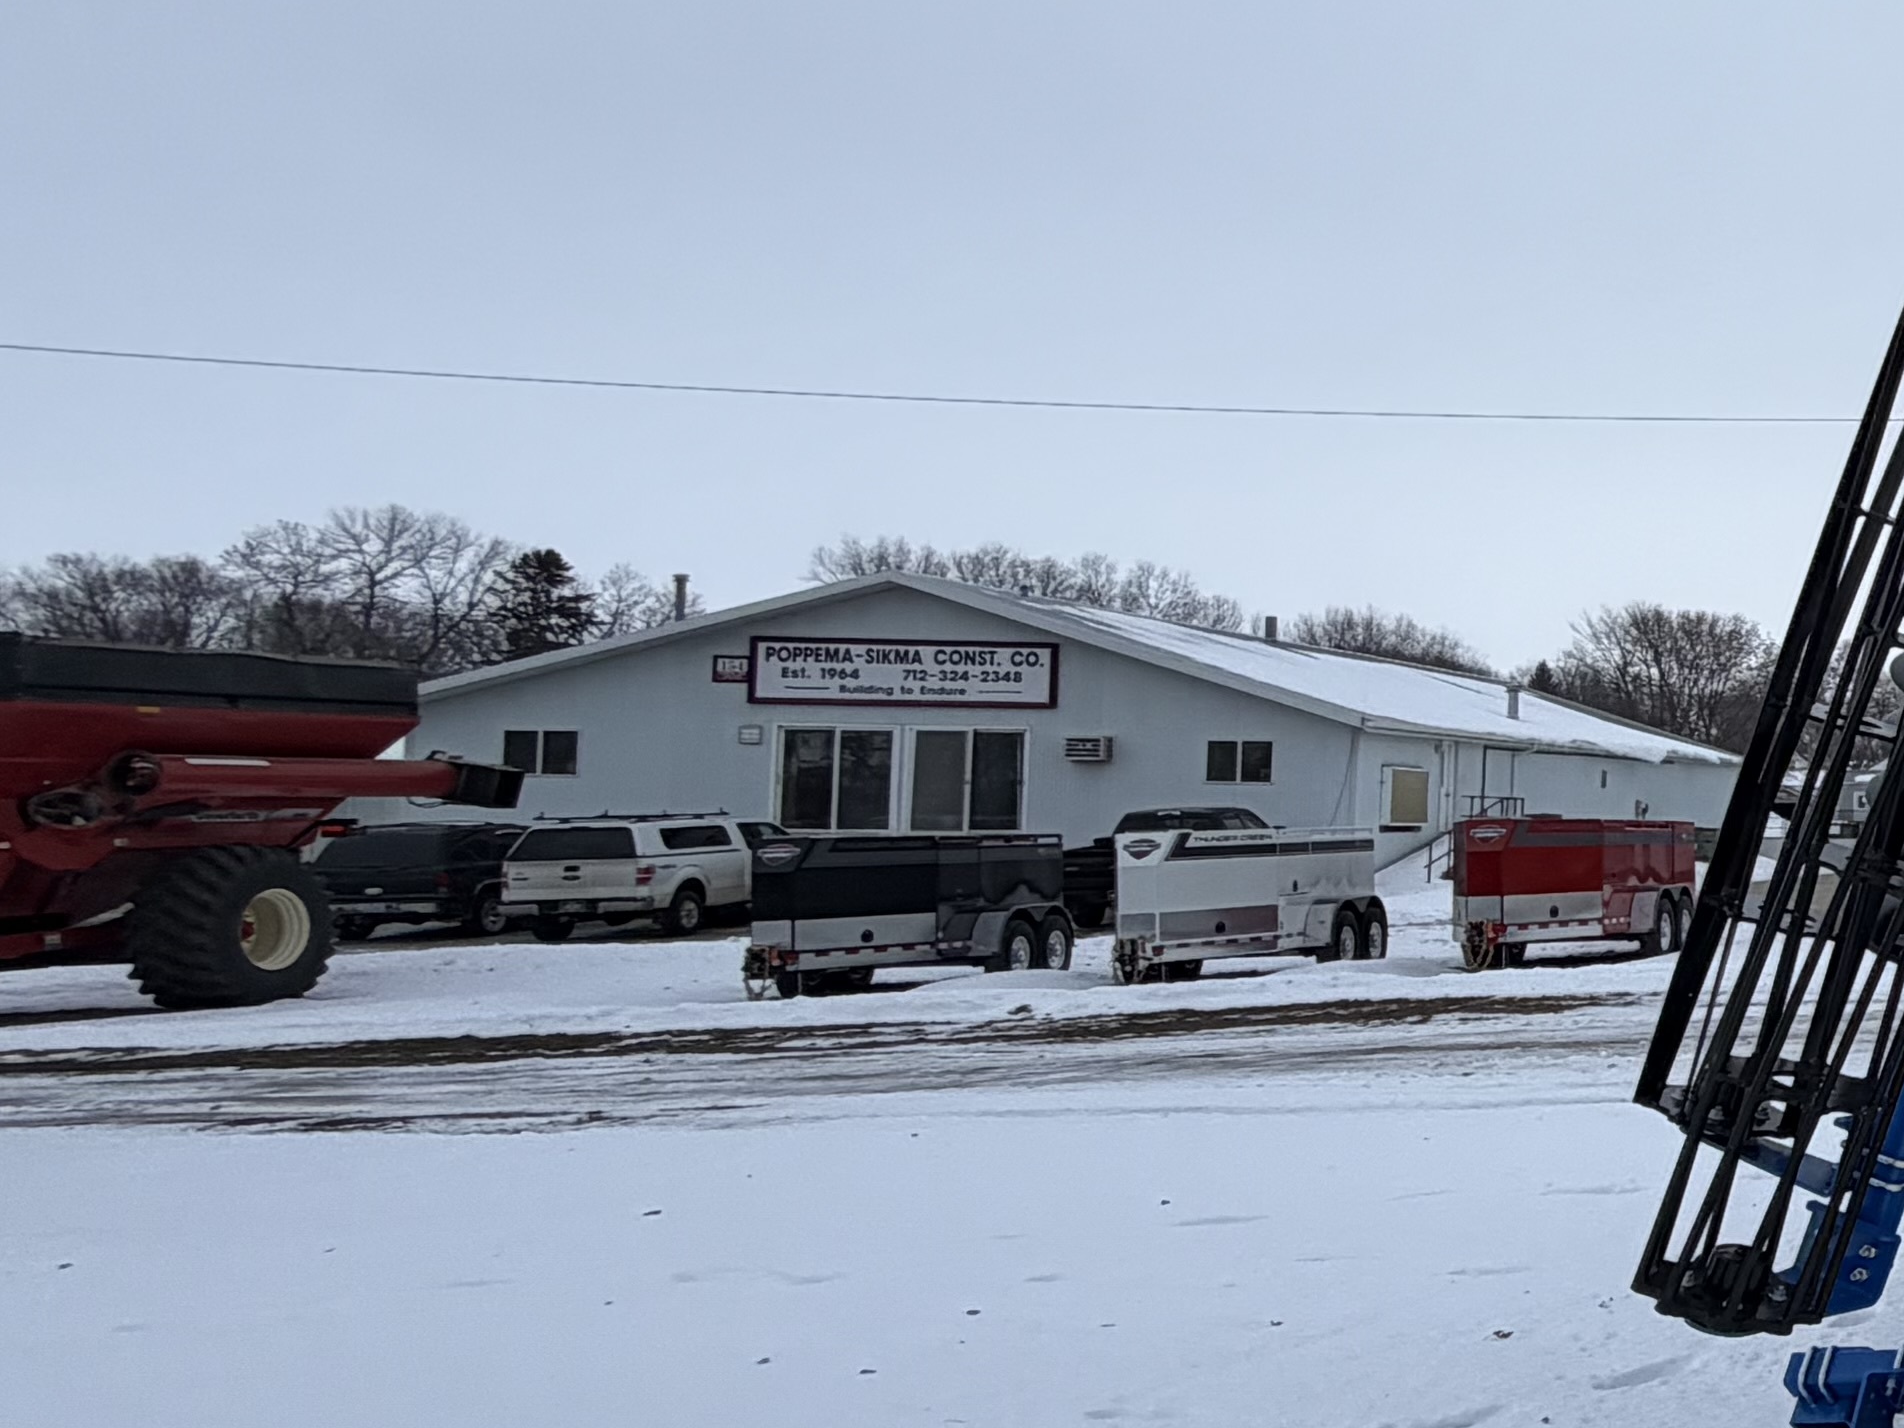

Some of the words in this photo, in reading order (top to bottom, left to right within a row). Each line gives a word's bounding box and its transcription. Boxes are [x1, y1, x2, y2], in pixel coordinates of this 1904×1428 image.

[765, 646, 923, 666] POPPEMA-SIKMA
[934, 649, 1002, 666] CONST.
[1010, 651, 1045, 668] CO.
[781, 667, 811, 679] Est.
[820, 668, 860, 680] 1964
[902, 669, 1023, 683] 712-324-2348
[839, 684, 894, 696] Building
[901, 686, 914, 695] to
[920, 686, 967, 695] Endure
